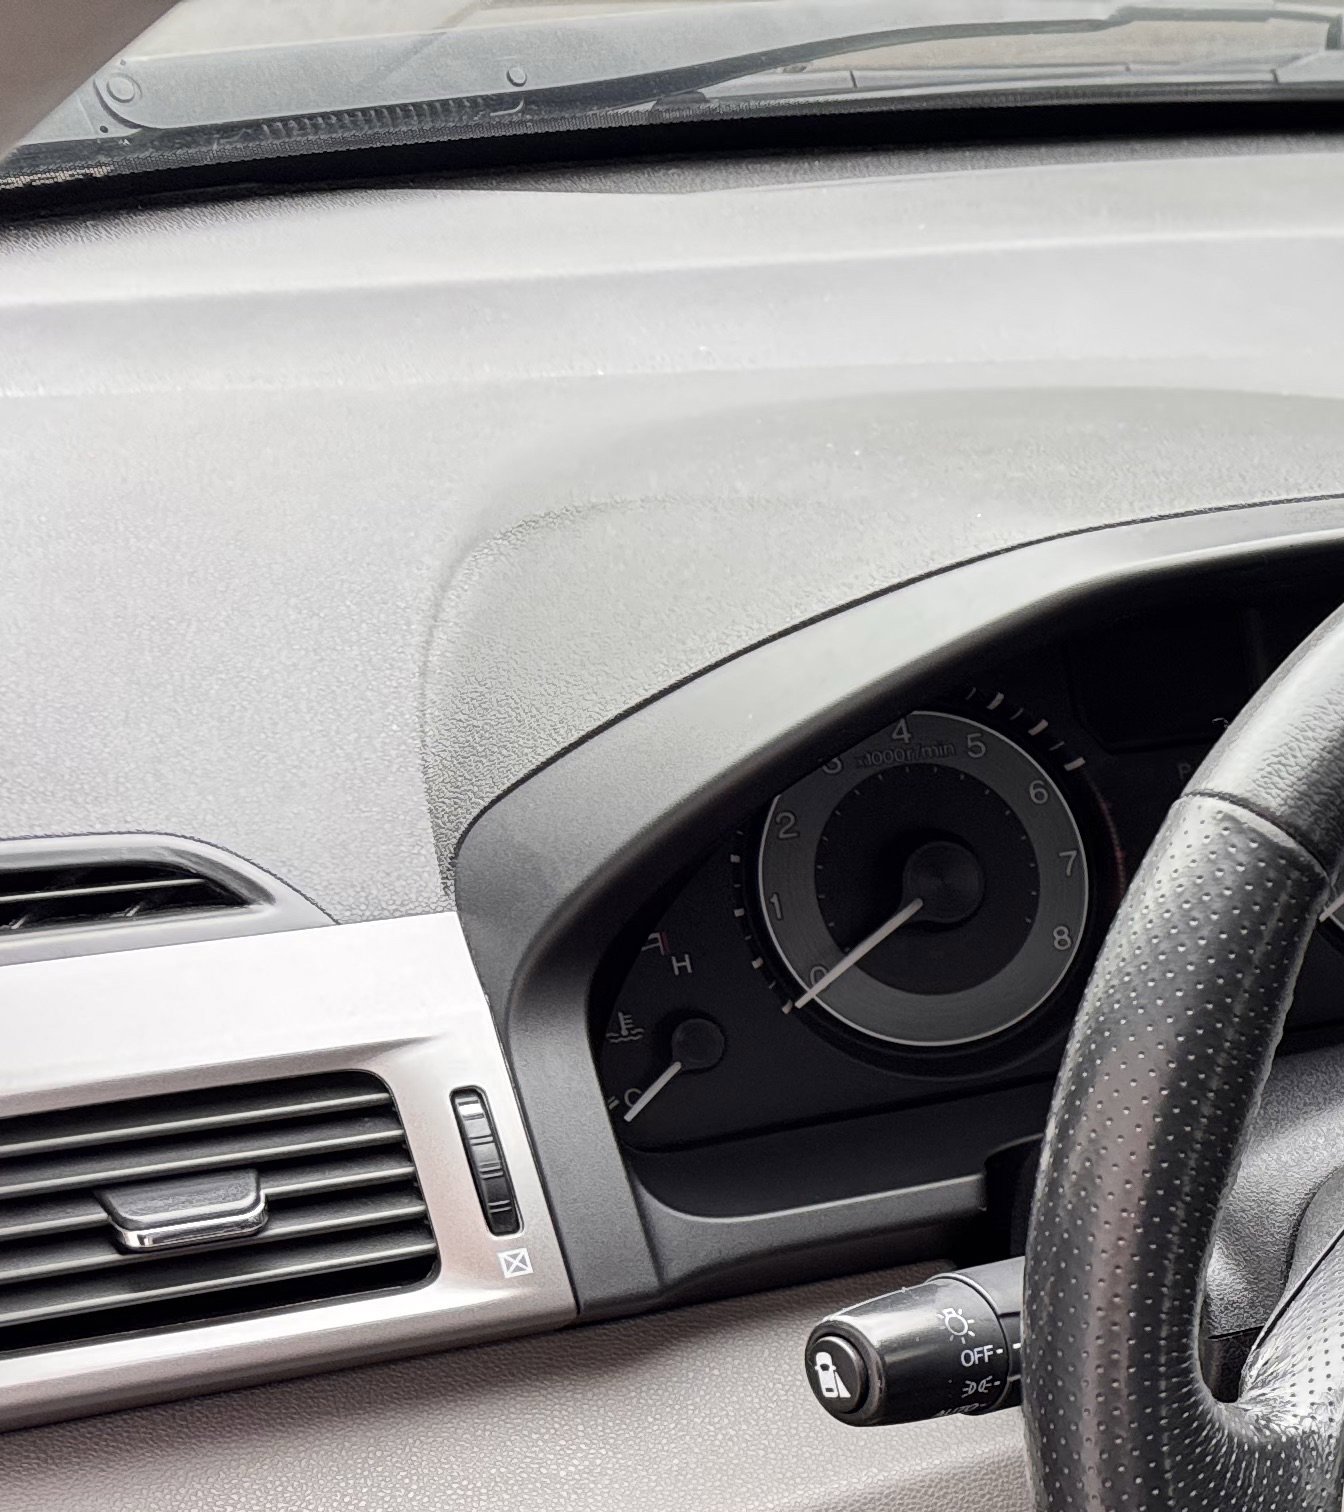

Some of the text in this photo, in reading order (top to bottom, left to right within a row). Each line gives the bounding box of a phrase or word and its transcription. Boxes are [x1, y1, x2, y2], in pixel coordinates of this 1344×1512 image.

[891, 717, 912, 744] 4
[965, 732, 987, 759] 5
[1028, 780, 1050, 804] 6
[774, 811, 799, 840] 2
[1058, 849, 1079, 876] 7
[768, 893, 785, 920] 1
[1052, 925, 1073, 951] 8
[671, 953, 693, 976] H
[960, 1344, 995, 1368] OFF
